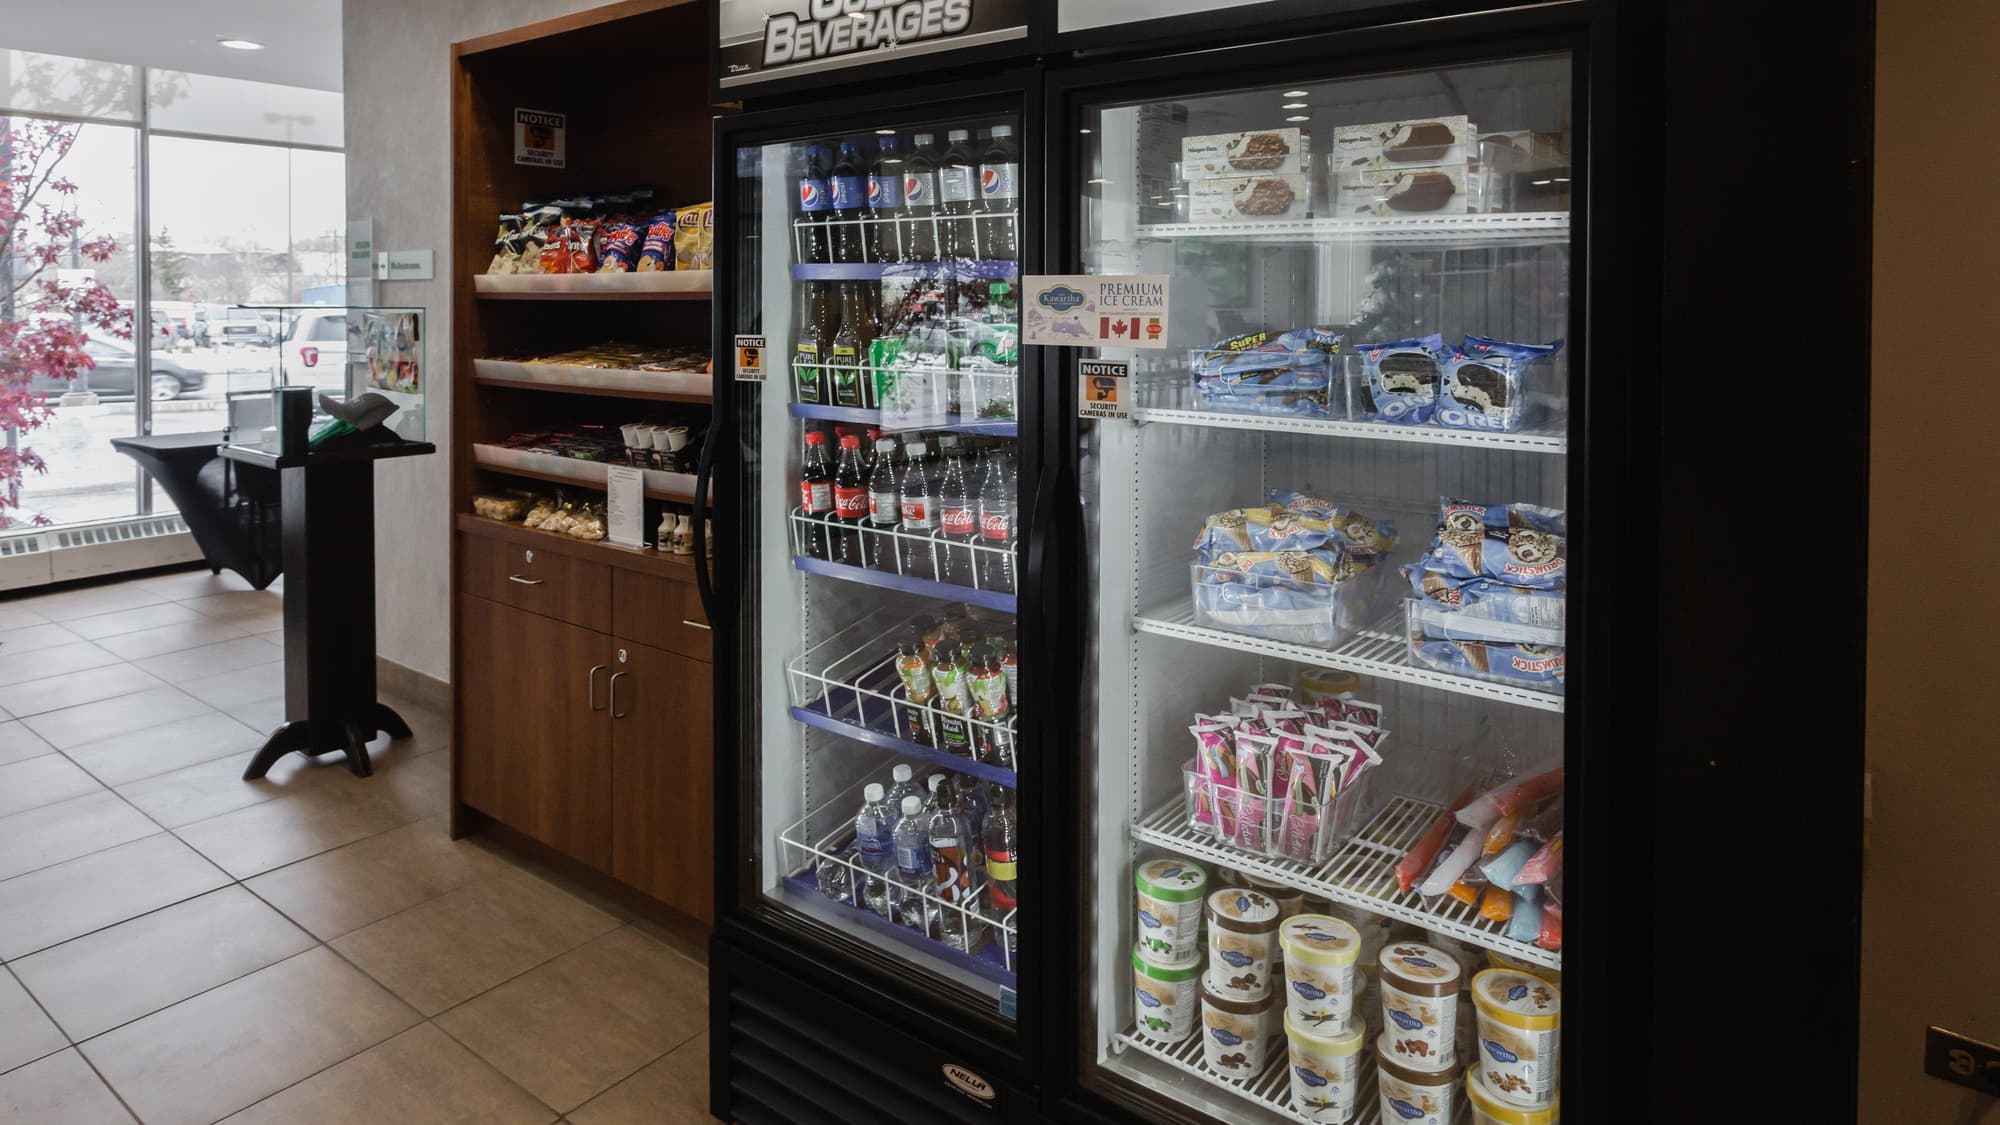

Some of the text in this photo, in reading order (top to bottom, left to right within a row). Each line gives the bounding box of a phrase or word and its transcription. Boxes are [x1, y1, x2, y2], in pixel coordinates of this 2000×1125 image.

[762, 1, 973, 65] BEVERAGES
[520, 112, 561, 127] NOTICE
[1099, 282, 1163, 296] PREMIUM
[1043, 293, 1080, 302] Kawartha
[1099, 295, 1163, 307] ICE CREAM
[737, 338, 765, 348] NOTICE
[1229, 332, 1267, 350] SUPER
[800, 352, 816, 361] PURE
[836, 356, 852, 364] PURE
[1082, 364, 1126, 377] NOTICE
[1090, 402, 1118, 411] SECURITY
[1080, 409, 1128, 419] CAMERAS IN USE
[950, 1068, 986, 1091] NELLA
